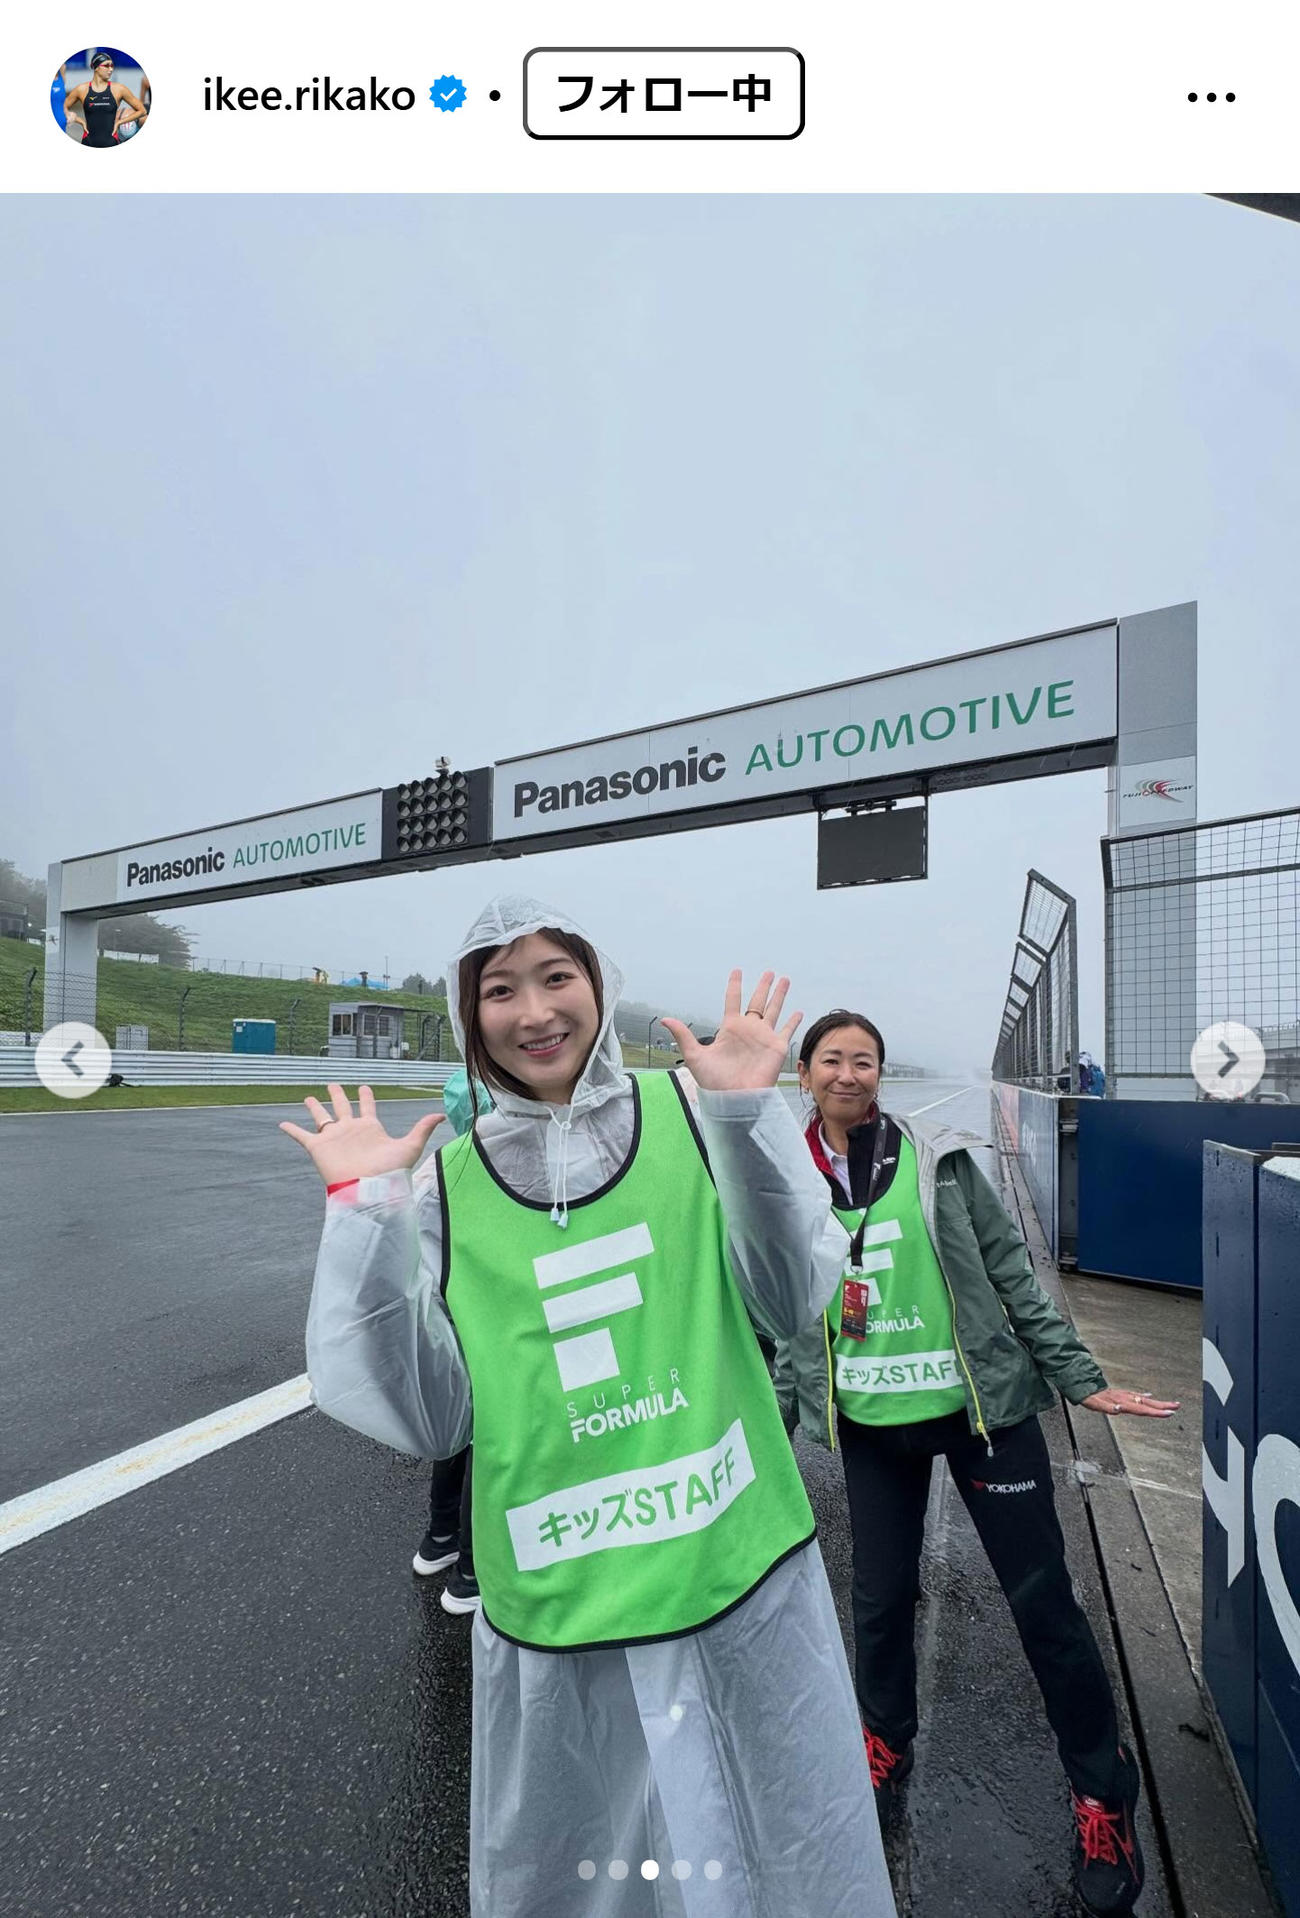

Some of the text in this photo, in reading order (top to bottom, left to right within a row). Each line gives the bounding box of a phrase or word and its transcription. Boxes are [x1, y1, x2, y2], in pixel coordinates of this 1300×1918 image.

[513, 680, 1075, 818] Panasonic AUTOMOTIVE
[127, 822, 367, 888] Panasonic AUTOMOTIVE
[865, 1315, 926, 1335] ORMULA
[866, 1304, 920, 1321] UPER
[566, 1367, 680, 1419] SUPER
[842, 1358, 961, 1388] キッズSTAF
[570, 1386, 690, 1444] FORMULA
[538, 1446, 736, 1548] キッズSTAFF
[985, 1479, 1037, 1494] YOKOHAMA
